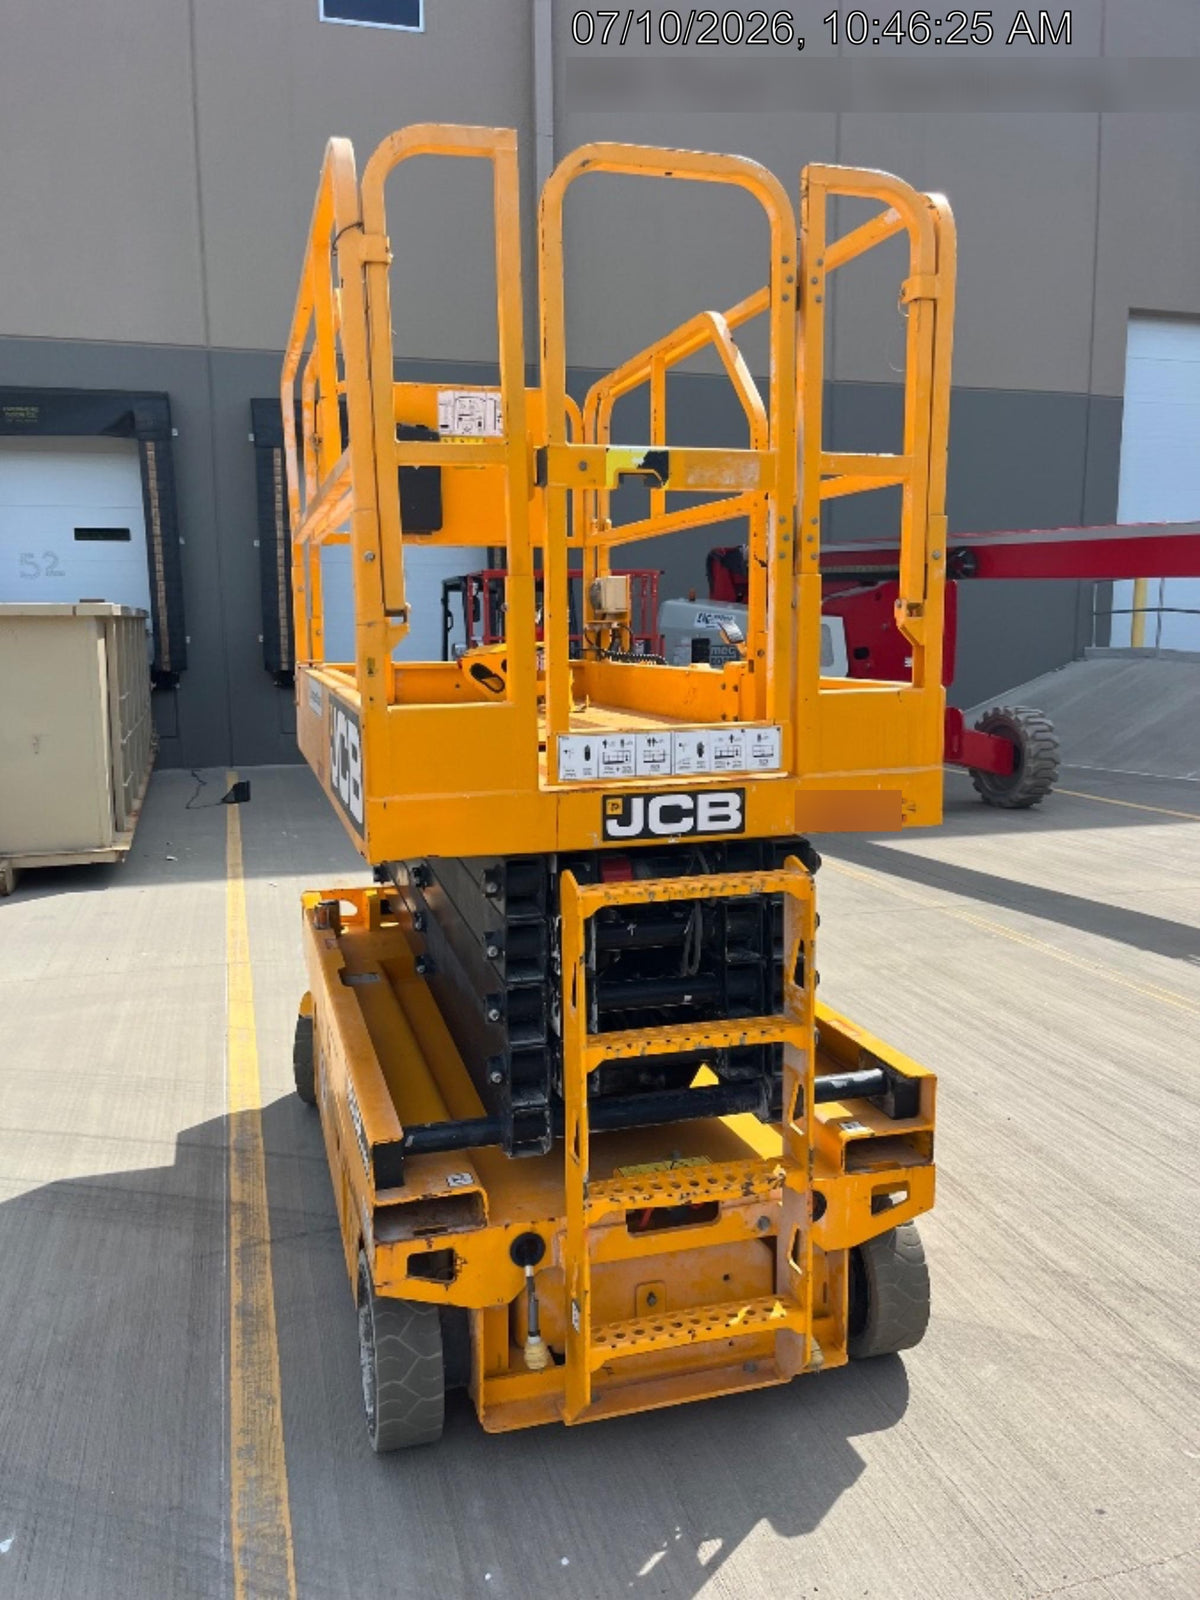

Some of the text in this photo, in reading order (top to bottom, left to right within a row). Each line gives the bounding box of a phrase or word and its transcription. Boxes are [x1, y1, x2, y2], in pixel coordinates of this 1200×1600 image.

[20, 551, 65, 580] 52
[330, 703, 364, 824] JCB
[605, 792, 742, 837] JCB
